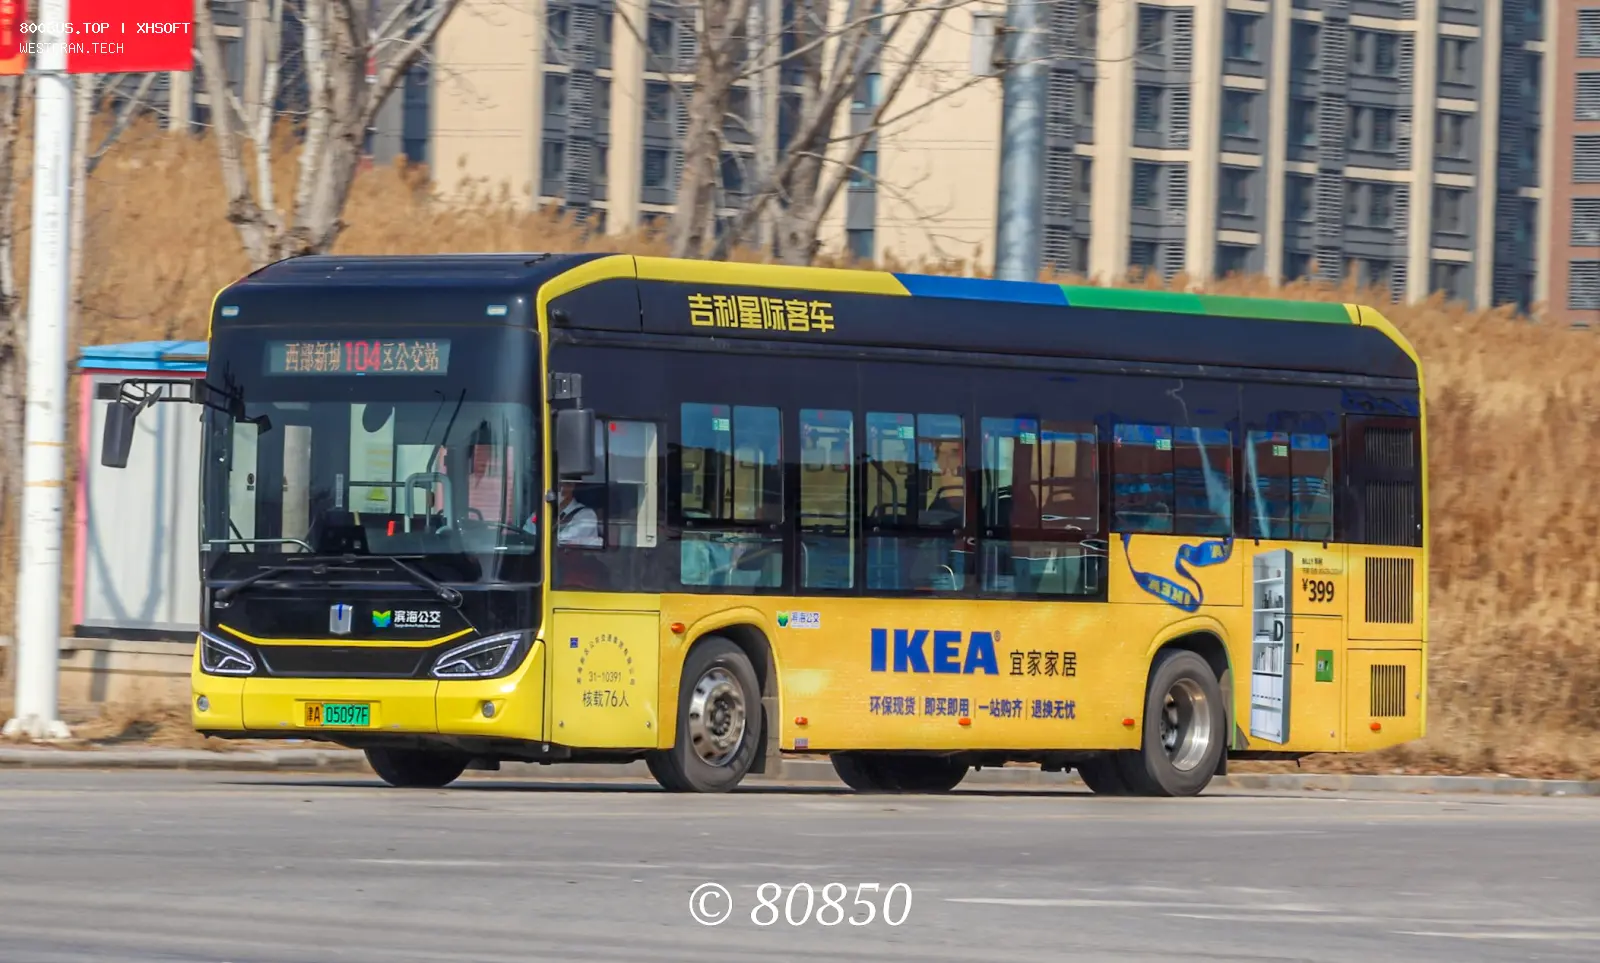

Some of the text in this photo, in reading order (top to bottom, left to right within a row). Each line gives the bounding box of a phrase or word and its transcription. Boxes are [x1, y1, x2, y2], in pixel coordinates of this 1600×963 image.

[688, 293, 835, 333] 吉利星际客车
[345, 340, 381, 372] 104
[1302, 578, 1335, 603] ¥399
[394, 610, 441, 623] 滨海公交
[1009, 649, 1078, 678] 宜家家居
[582, 690, 629, 708] 核载76人
[869, 695, 1076, 720] 环保现货 即买即用 一站购齐 退换无忧
[325, 706, 369, 723] 05097F
